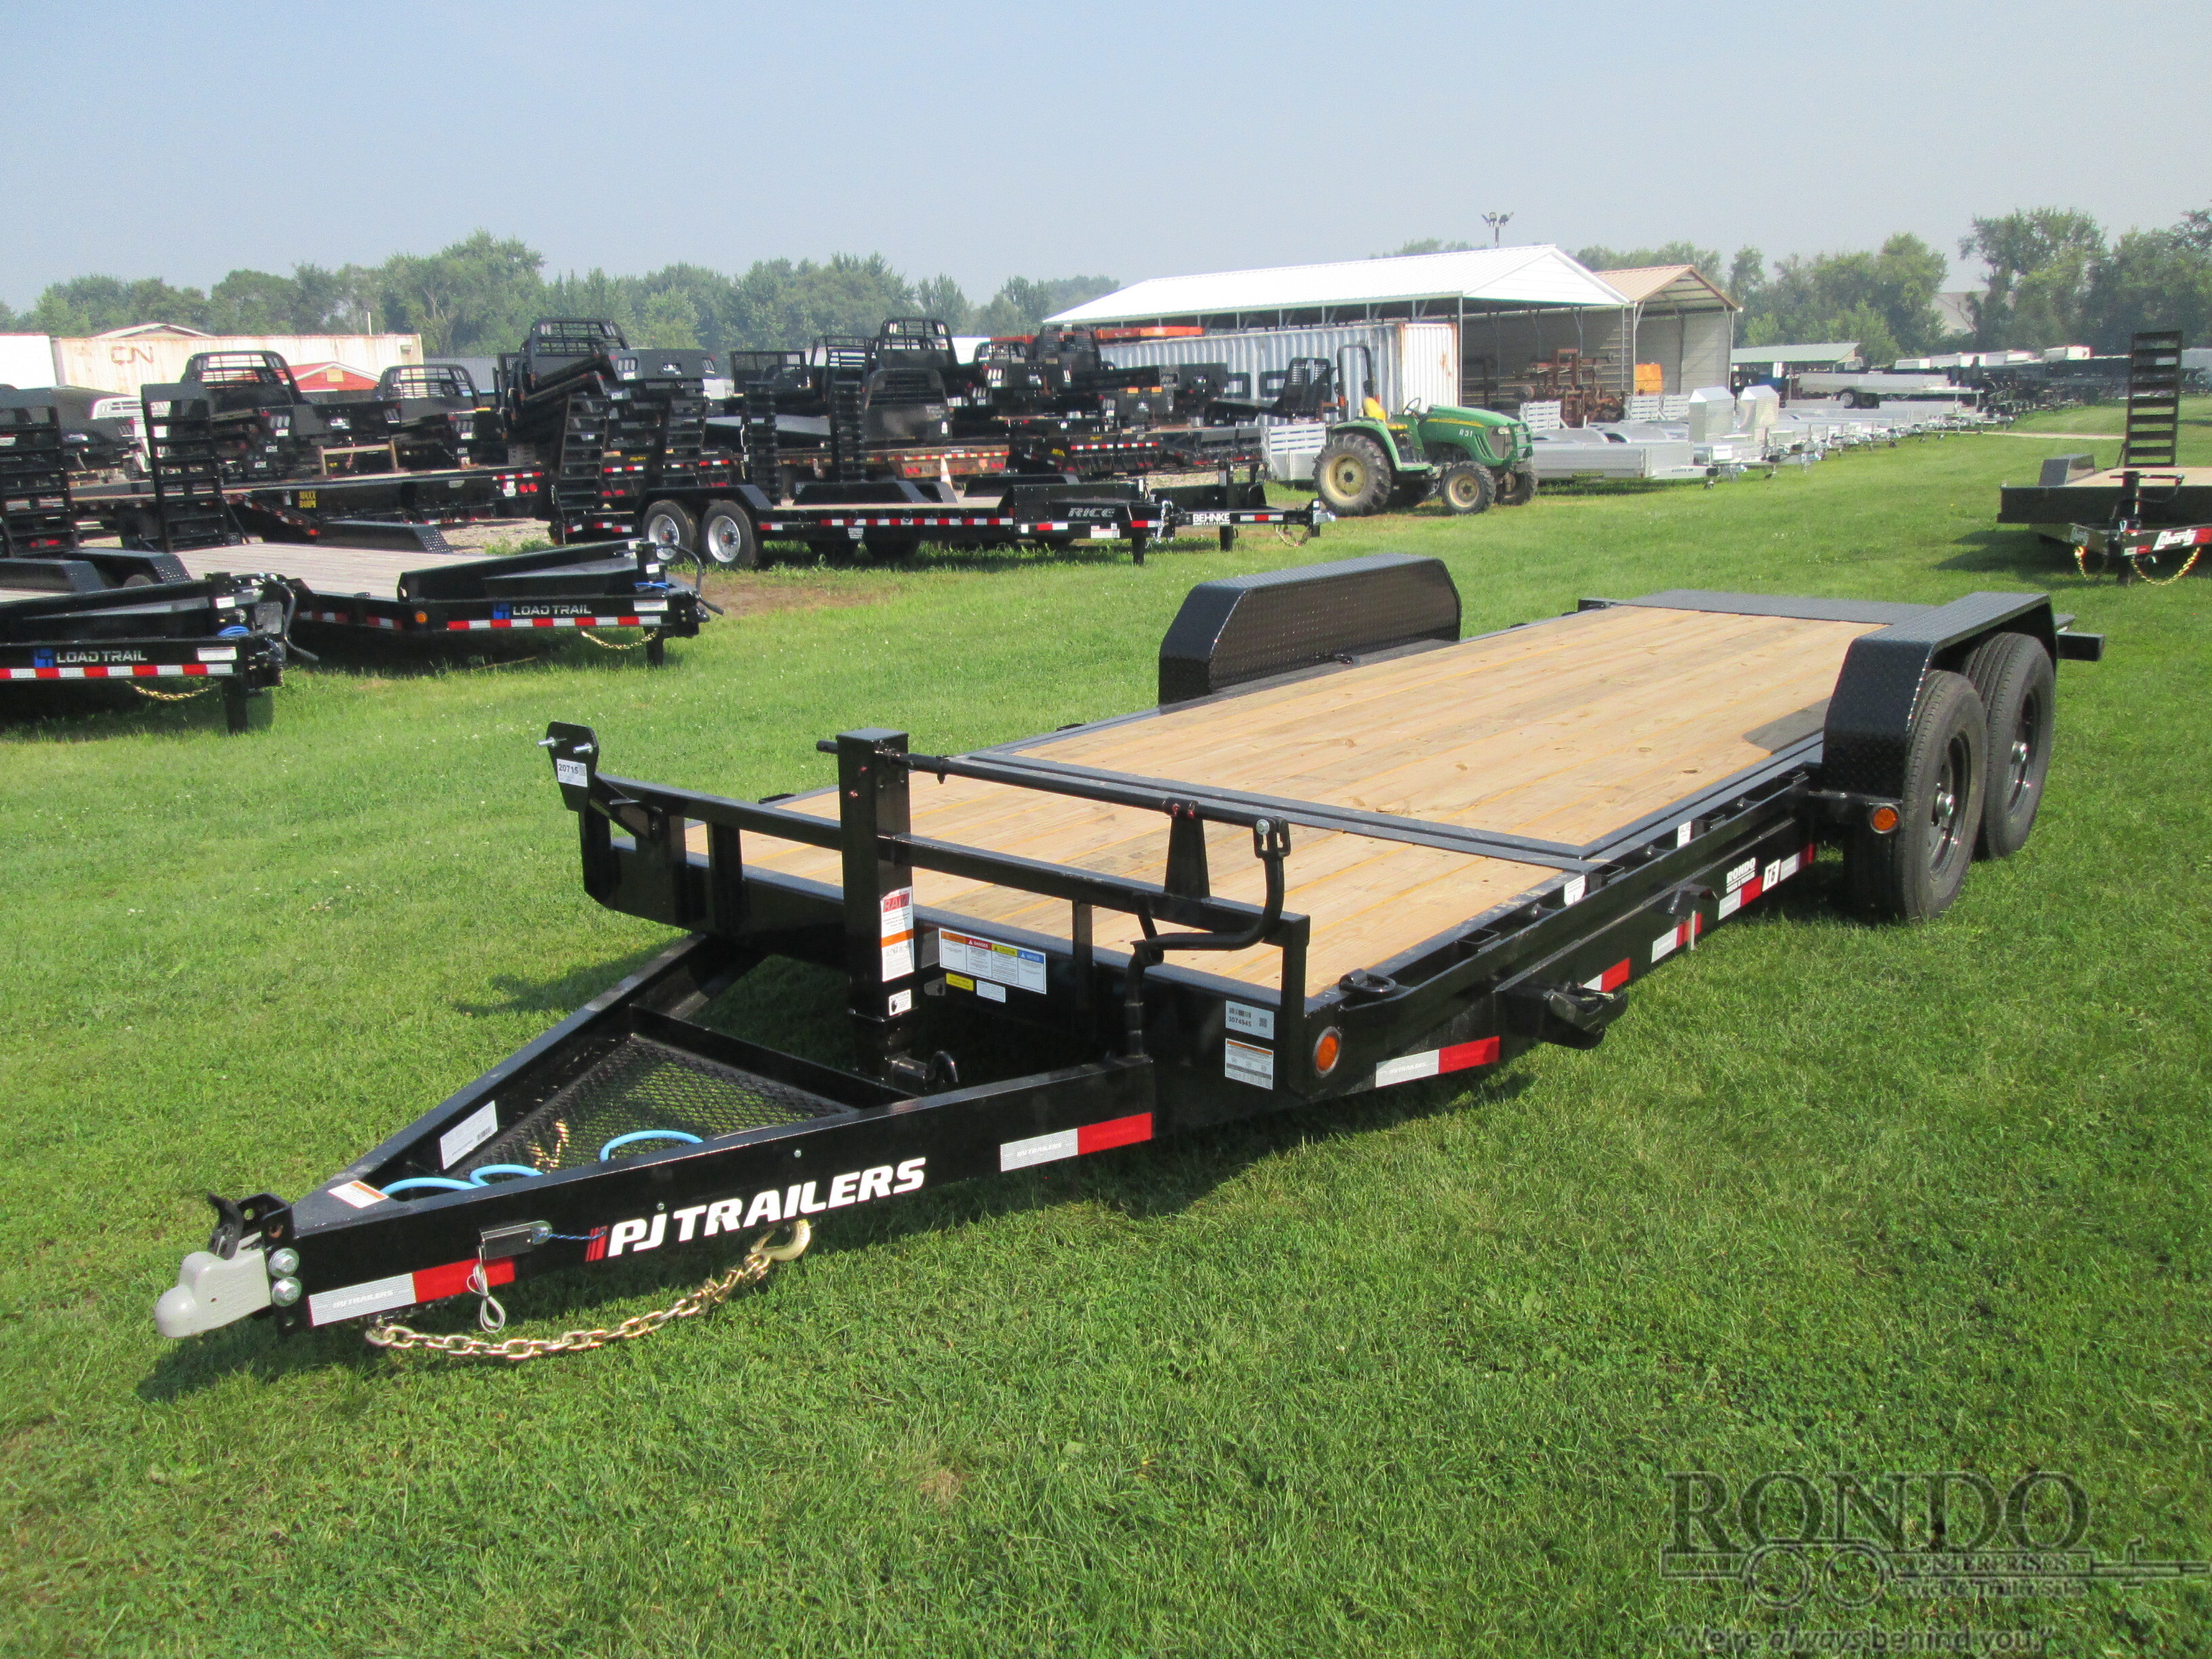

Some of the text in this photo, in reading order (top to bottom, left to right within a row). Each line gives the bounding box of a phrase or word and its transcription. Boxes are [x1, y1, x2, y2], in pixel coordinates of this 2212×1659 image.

[1068, 508, 1115, 518] RICE
[1193, 512, 1231, 523] BEHNKE
[2152, 529, 2198, 551] Liberty
[512, 604, 592, 616] LOAD TRAIL
[56, 649, 148, 663] LOAD TRAIL
[558, 763, 579, 775] 20715
[1726, 857, 1756, 884] RONDO
[1767, 865, 1776, 886] T6
[973, 941, 989, 949] DANGER
[1228, 1016, 1252, 1027] 3074945
[609, 1157, 926, 1258] PJ TRAILERS
